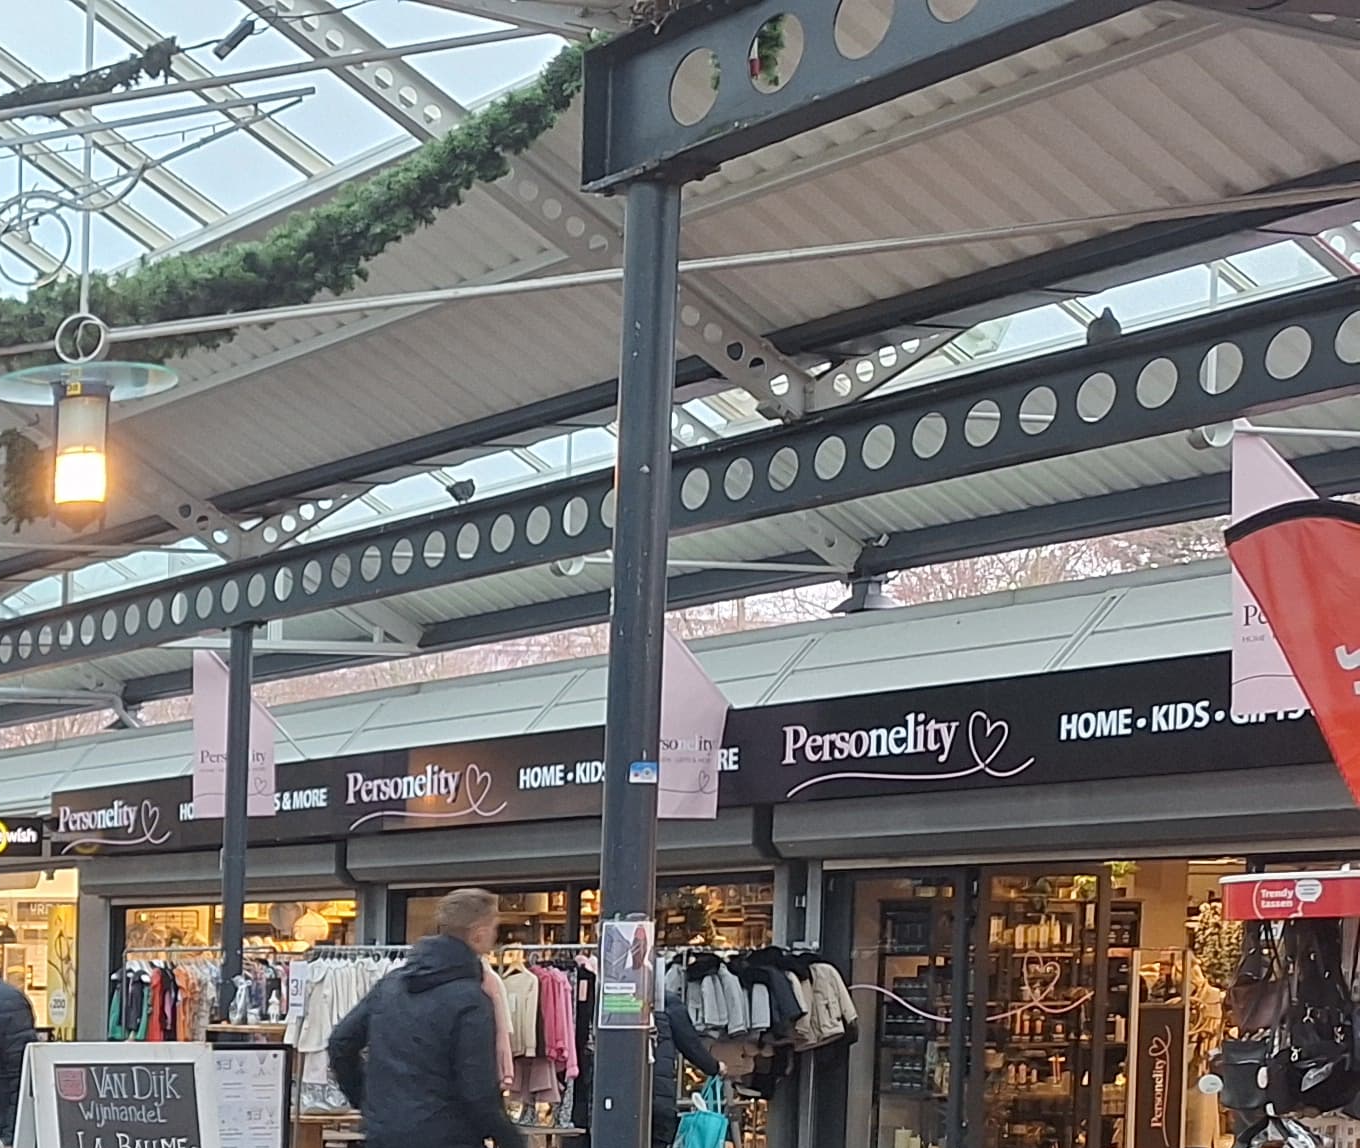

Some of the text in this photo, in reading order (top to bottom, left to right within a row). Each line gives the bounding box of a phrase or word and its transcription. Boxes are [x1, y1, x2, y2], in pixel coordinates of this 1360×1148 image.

[782, 712, 960, 765] Personelity
[1059, 708, 1133, 741] HOME
[1151, 700, 1211, 733] KIDS
[345, 764, 462, 805] Personelity
[519, 765, 565, 791] HOME
[58, 800, 139, 833] Personelity
[292, 787, 329, 809] MORE
[1260, 887, 1295, 899] Trendy
[89, 1065, 129, 1100] VAN
[1150, 1058, 1168, 1128] Personelity
